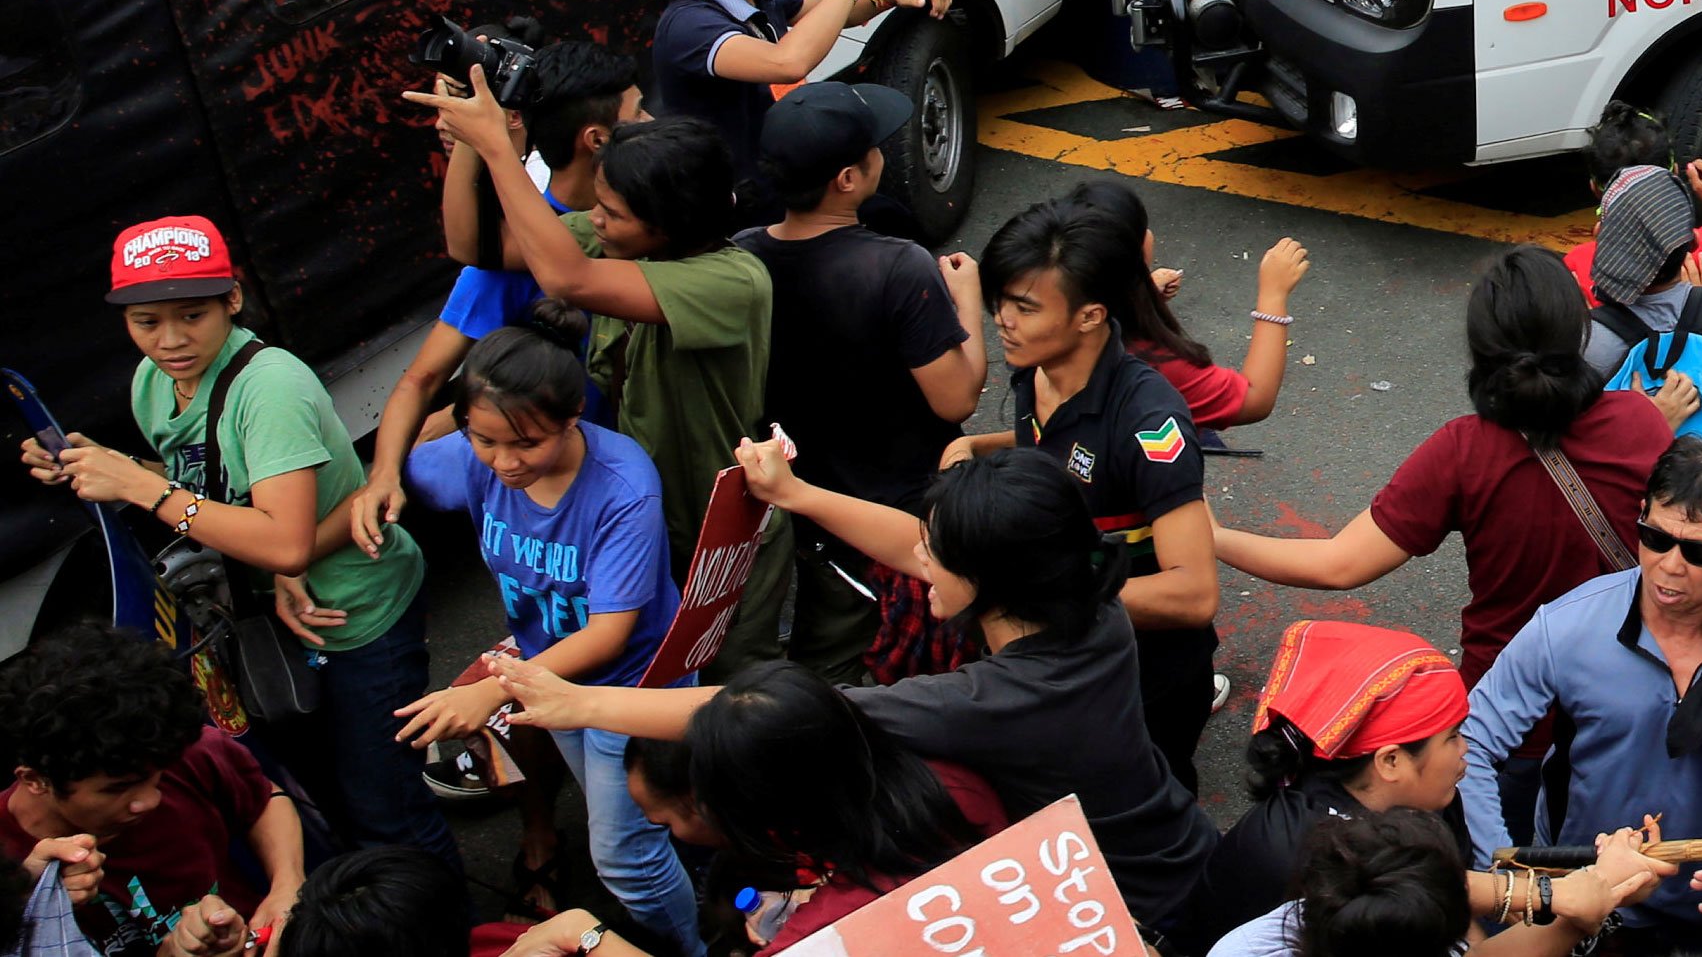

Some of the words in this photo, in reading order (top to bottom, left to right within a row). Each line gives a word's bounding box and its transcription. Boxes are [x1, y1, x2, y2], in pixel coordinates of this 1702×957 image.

[123, 226, 210, 267] CHAMPIONS
[134, 255, 151, 269] 20
[185, 249, 201, 262] 13
[1073, 449, 1095, 467] ONE
